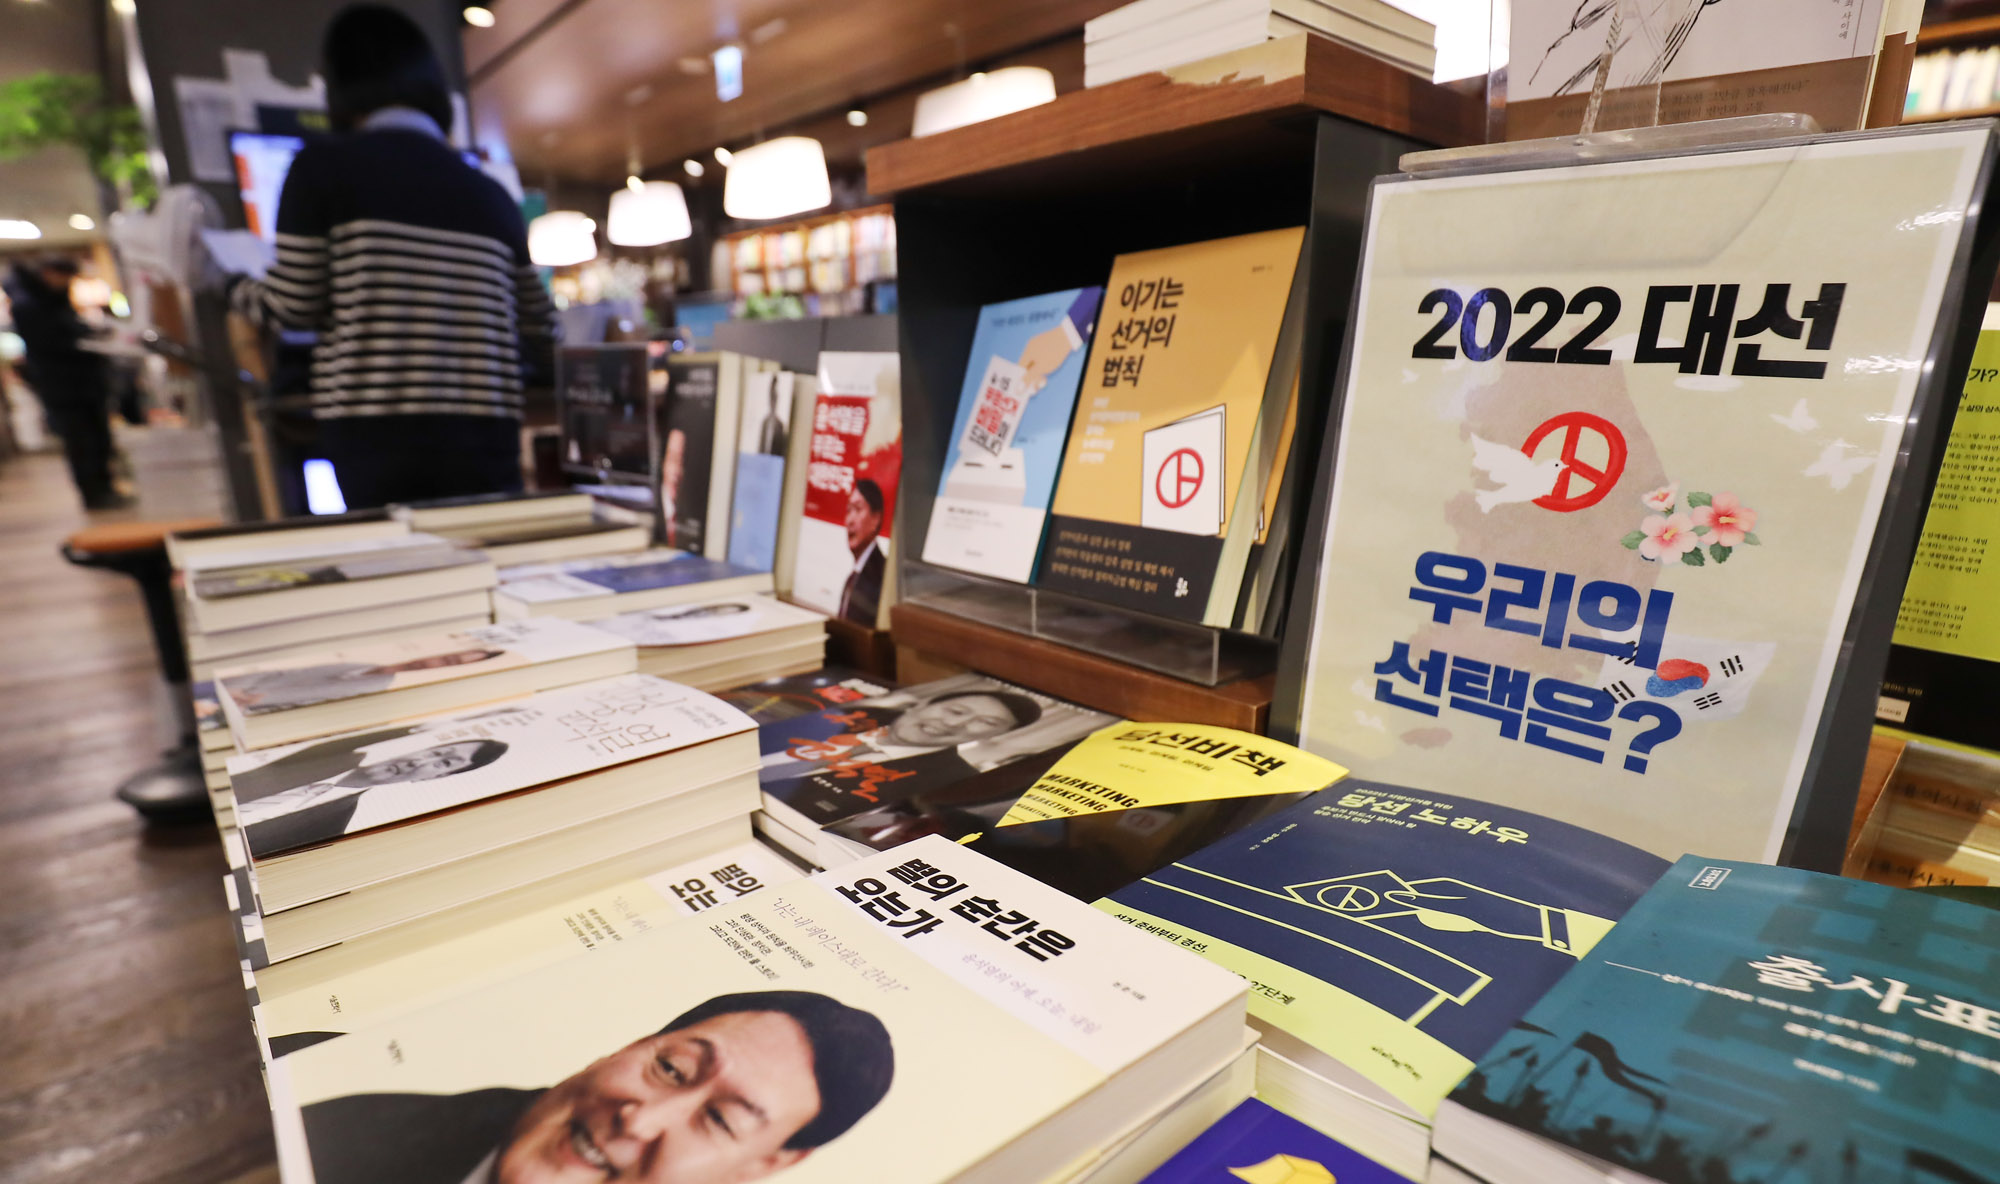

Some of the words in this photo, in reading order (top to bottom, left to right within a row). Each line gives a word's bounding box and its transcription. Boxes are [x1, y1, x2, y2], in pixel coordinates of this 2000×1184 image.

[1121, 277, 1185, 312] 이기는
[1111, 314, 1176, 351] 선거의
[1411, 285, 1623, 366] 2022
[1633, 282, 1848, 379] 대선
[1101, 354, 1145, 389] 법칙
[1407, 550, 1675, 671] 우리의
[1373, 639, 1684, 775] 선택은?
[1112, 729, 1287, 777] 당선비책
[1024, 793, 1079, 816] MARKETING
[1033, 783, 1108, 813] MARKETING
[1043, 773, 1140, 809] MARKETING
[1015, 803, 1052, 819] MARKETING
[1337, 792, 1413, 816] 당선
[1408, 807, 1529, 844] 노하우
[709, 863, 765, 898] 별의
[725, 918, 740, 931] 그의
[794, 915, 814, 929] 내
[834, 876, 945, 940] 오는가
[886, 857, 969, 904] 별의
[949, 895, 1077, 963] 순간은
[708, 924, 725, 939] 그리고
[723, 934, 745, 952] 도전에
[737, 948, 756, 961] 관한
[740, 912, 757, 927] 평생
[750, 919, 772, 937] 상식과
[765, 932, 789, 949] 원칙을
[1134, 920, 1182, 943] 준비부터
[1180, 937, 1209, 954] 경선,
[1747, 953, 2000, 1041] 출사표
